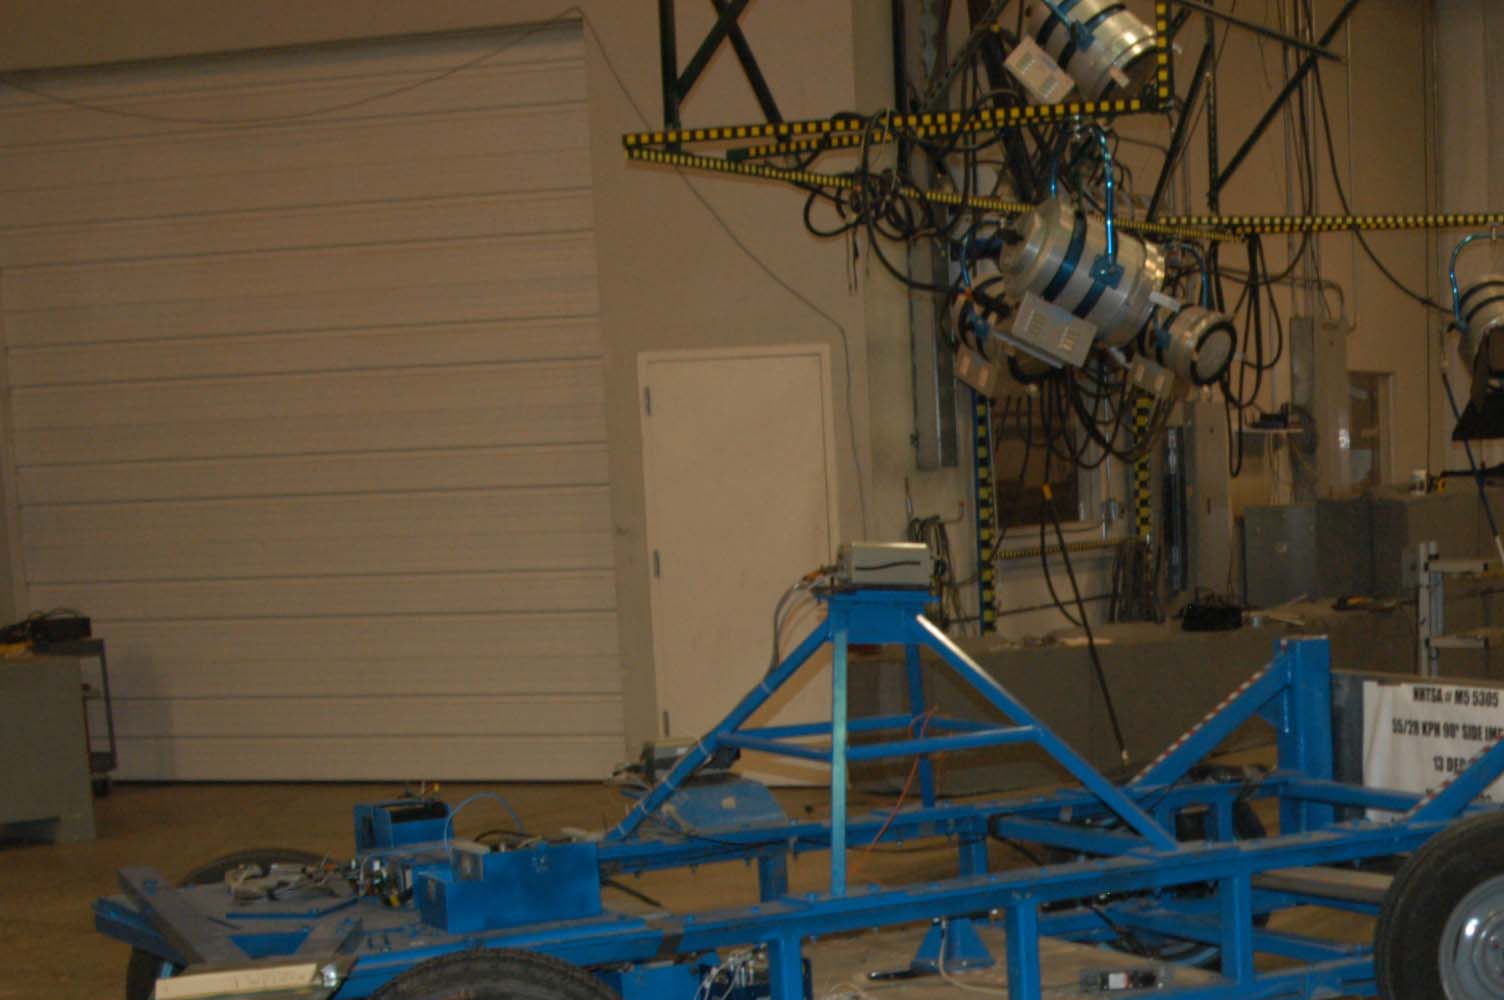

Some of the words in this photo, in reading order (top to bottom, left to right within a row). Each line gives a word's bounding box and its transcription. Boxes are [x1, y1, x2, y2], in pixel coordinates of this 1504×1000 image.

[1413, 687, 1442, 703] NHTSA
[1454, 689, 1470, 704] M5
[1472, 690, 1499, 708] 5305
[1421, 720, 1441, 737] KPH
[1462, 723, 1483, 741] SIDE
[1433, 755, 1444, 772] 13
